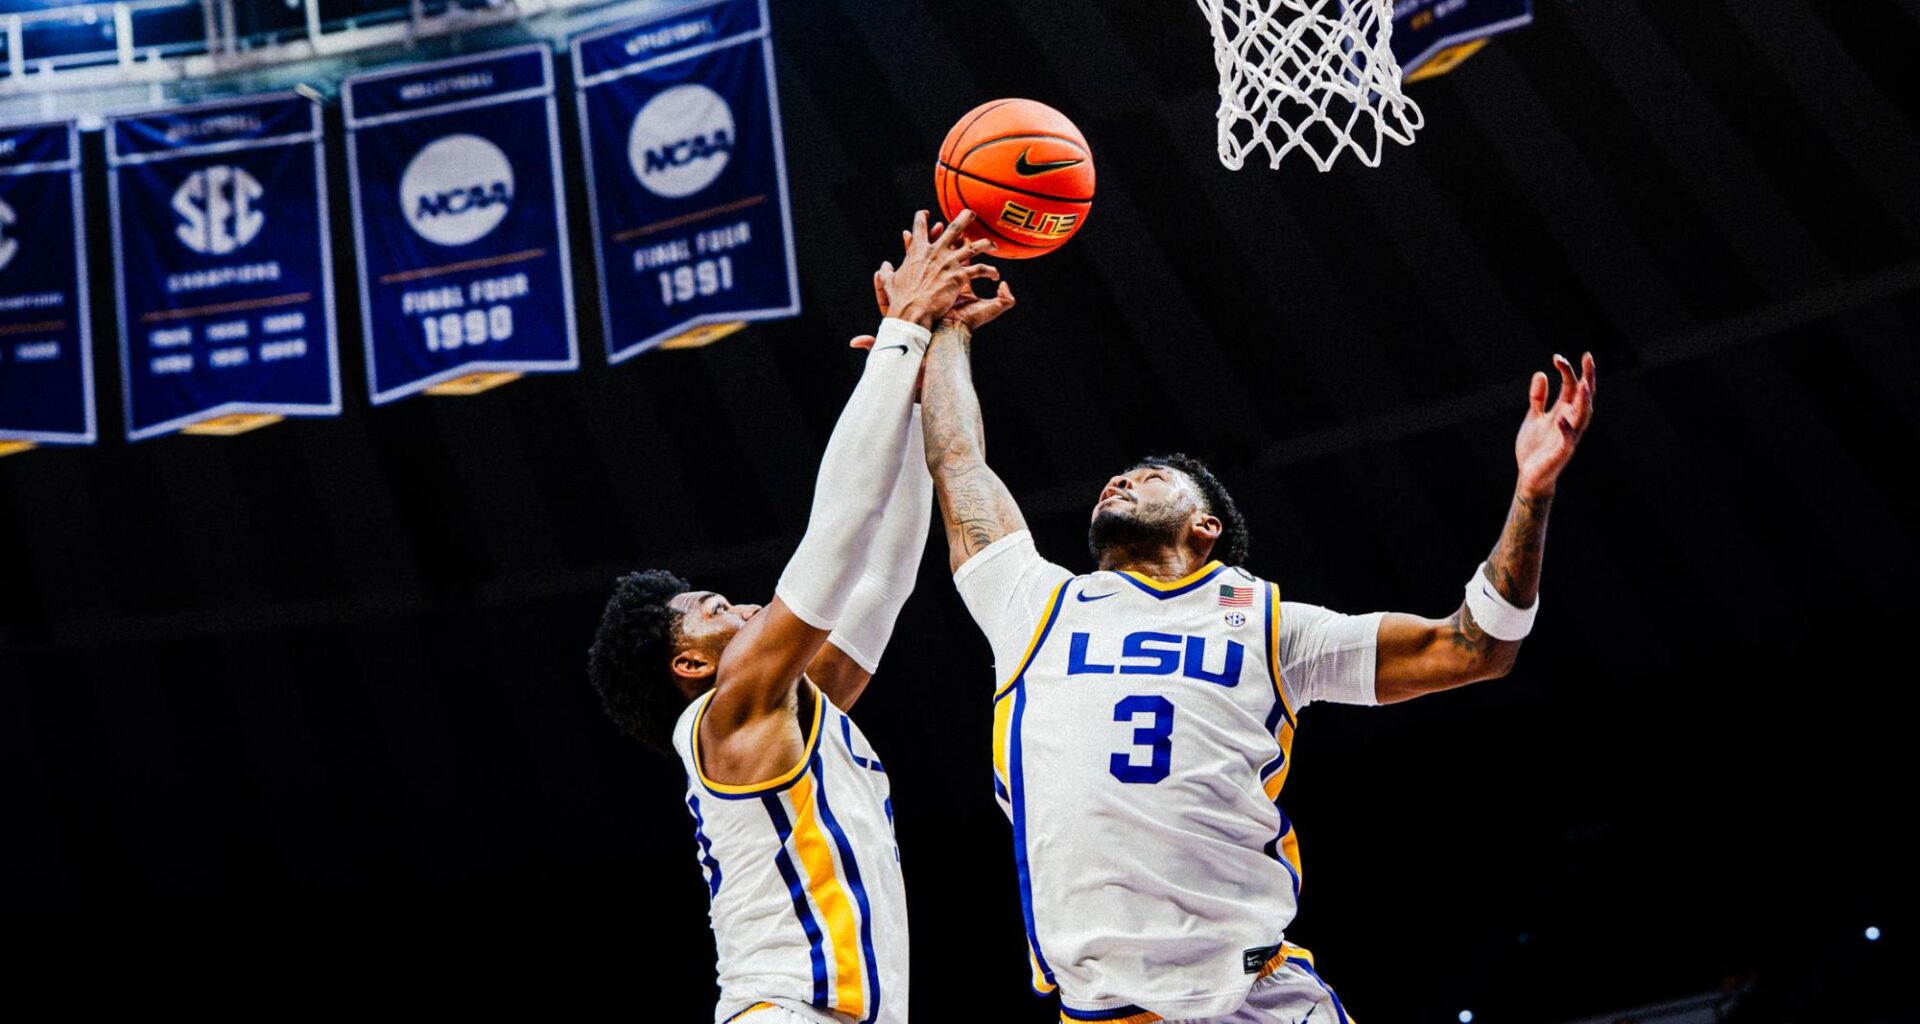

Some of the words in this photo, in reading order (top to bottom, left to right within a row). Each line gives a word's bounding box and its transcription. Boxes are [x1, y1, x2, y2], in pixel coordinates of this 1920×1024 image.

[643, 129, 732, 174] NCAA
[172, 165, 264, 254] SEC
[416, 181, 511, 221] NCAA
[1001, 200, 1079, 234] ELITE
[633, 238, 691, 272] FINAL
[695, 221, 752, 254] FOUR
[402, 285, 465, 315] FINAL
[469, 272, 530, 304] FOUR
[658, 256, 734, 306] 1991
[423, 304, 514, 353] 1990
[1225, 611, 1246, 628] SEC
[1067, 631, 1245, 688] LSU
[1109, 695, 1175, 784] 3
